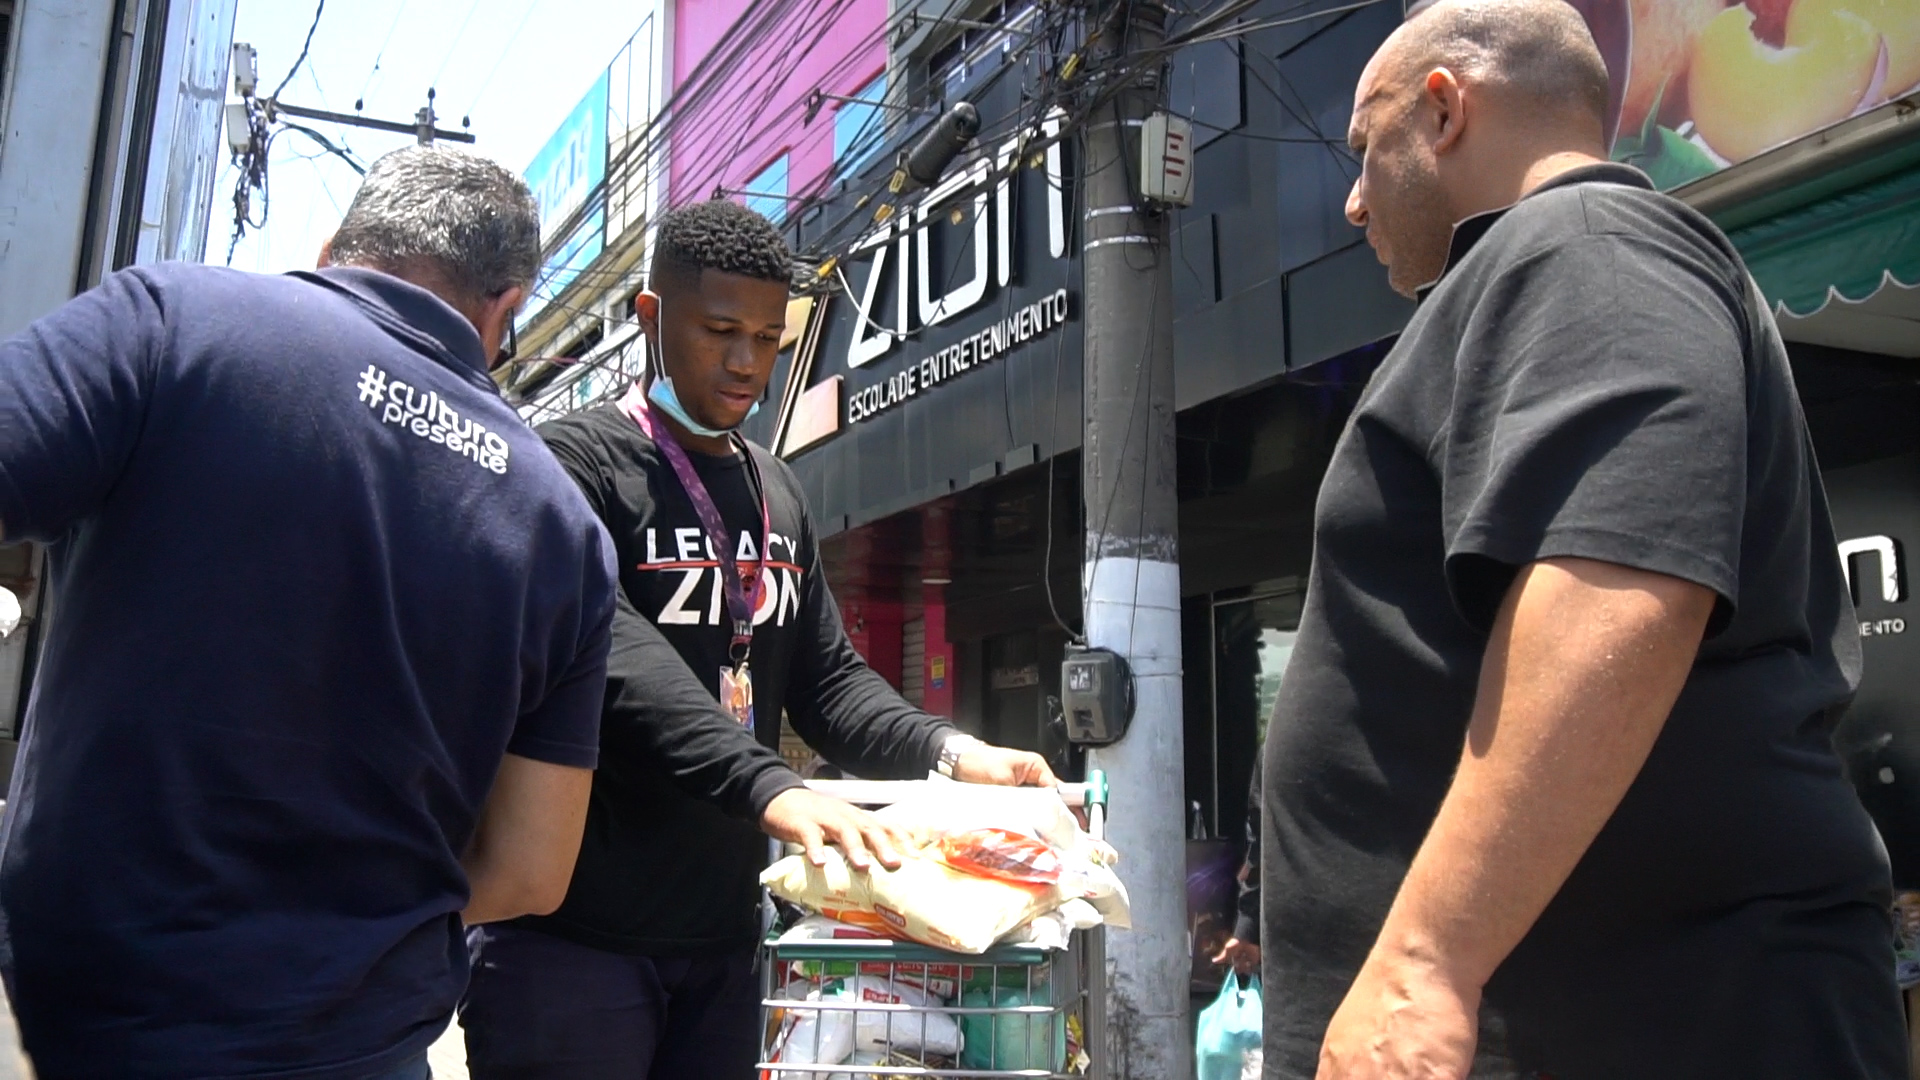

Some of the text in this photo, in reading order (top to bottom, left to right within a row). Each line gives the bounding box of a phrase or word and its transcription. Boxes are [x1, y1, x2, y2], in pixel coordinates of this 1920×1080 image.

[848, 287, 1068, 424] ESCOLA DE ENTRETENIMENTO
[356, 364, 509, 460] #cultura
[382, 402, 508, 474] presente
